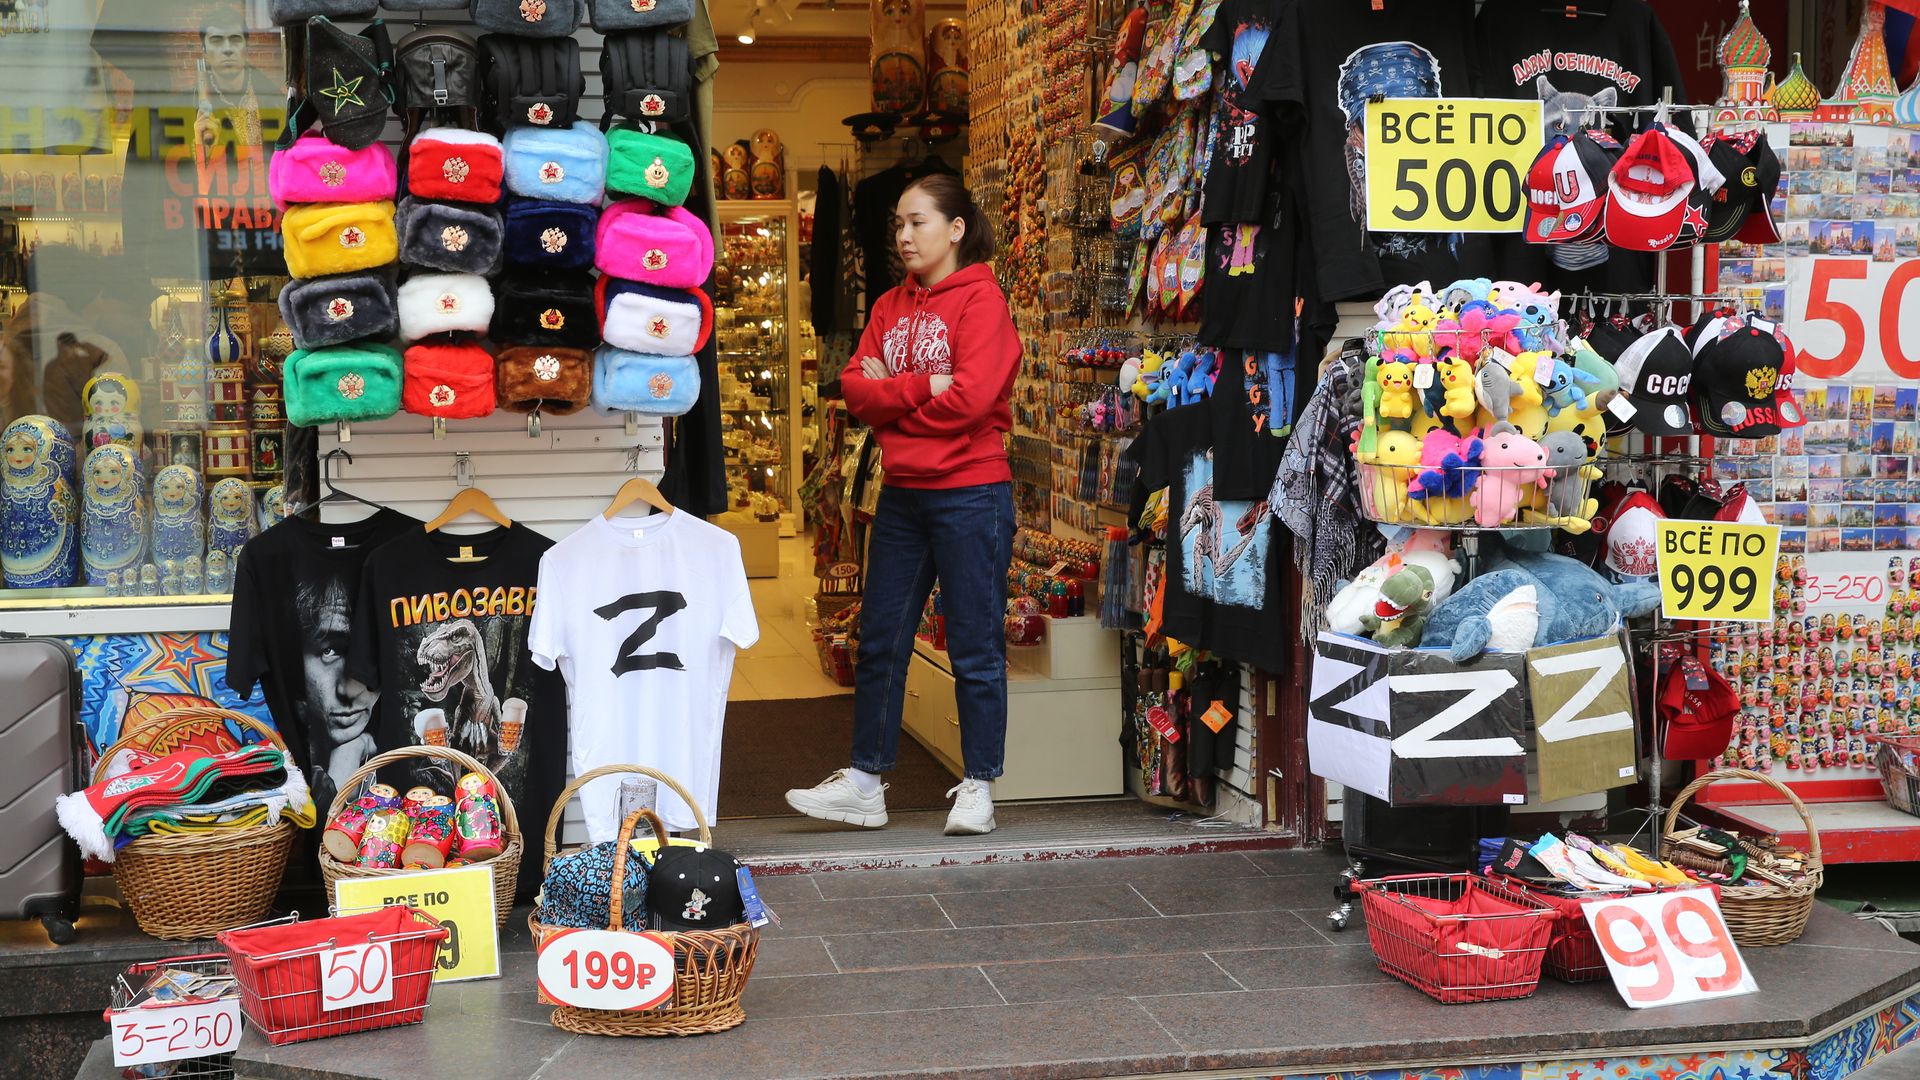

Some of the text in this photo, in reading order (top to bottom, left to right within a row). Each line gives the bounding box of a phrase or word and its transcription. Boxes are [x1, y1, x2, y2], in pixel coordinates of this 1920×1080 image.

[1512, 48, 1552, 86] ДАВАЙ
[1381, 104, 1527, 145] ВСЁ ПО
[1391, 158, 1521, 222] 500
[163, 198, 185, 230] В
[1733, 407, 1778, 433] USS
[1665, 525, 1766, 556] ВСЁ ПО
[1671, 563, 1757, 612] 999
[1806, 574, 1883, 603] 3=250
[593, 590, 687, 678] Z
[1388, 669, 1527, 759] Z
[1531, 646, 1634, 743] Z
[424, 891, 449, 906] ПО
[1594, 897, 1742, 1002] 99
[326, 944, 388, 1001] 50
[117, 1012, 232, 1056] 3=250
